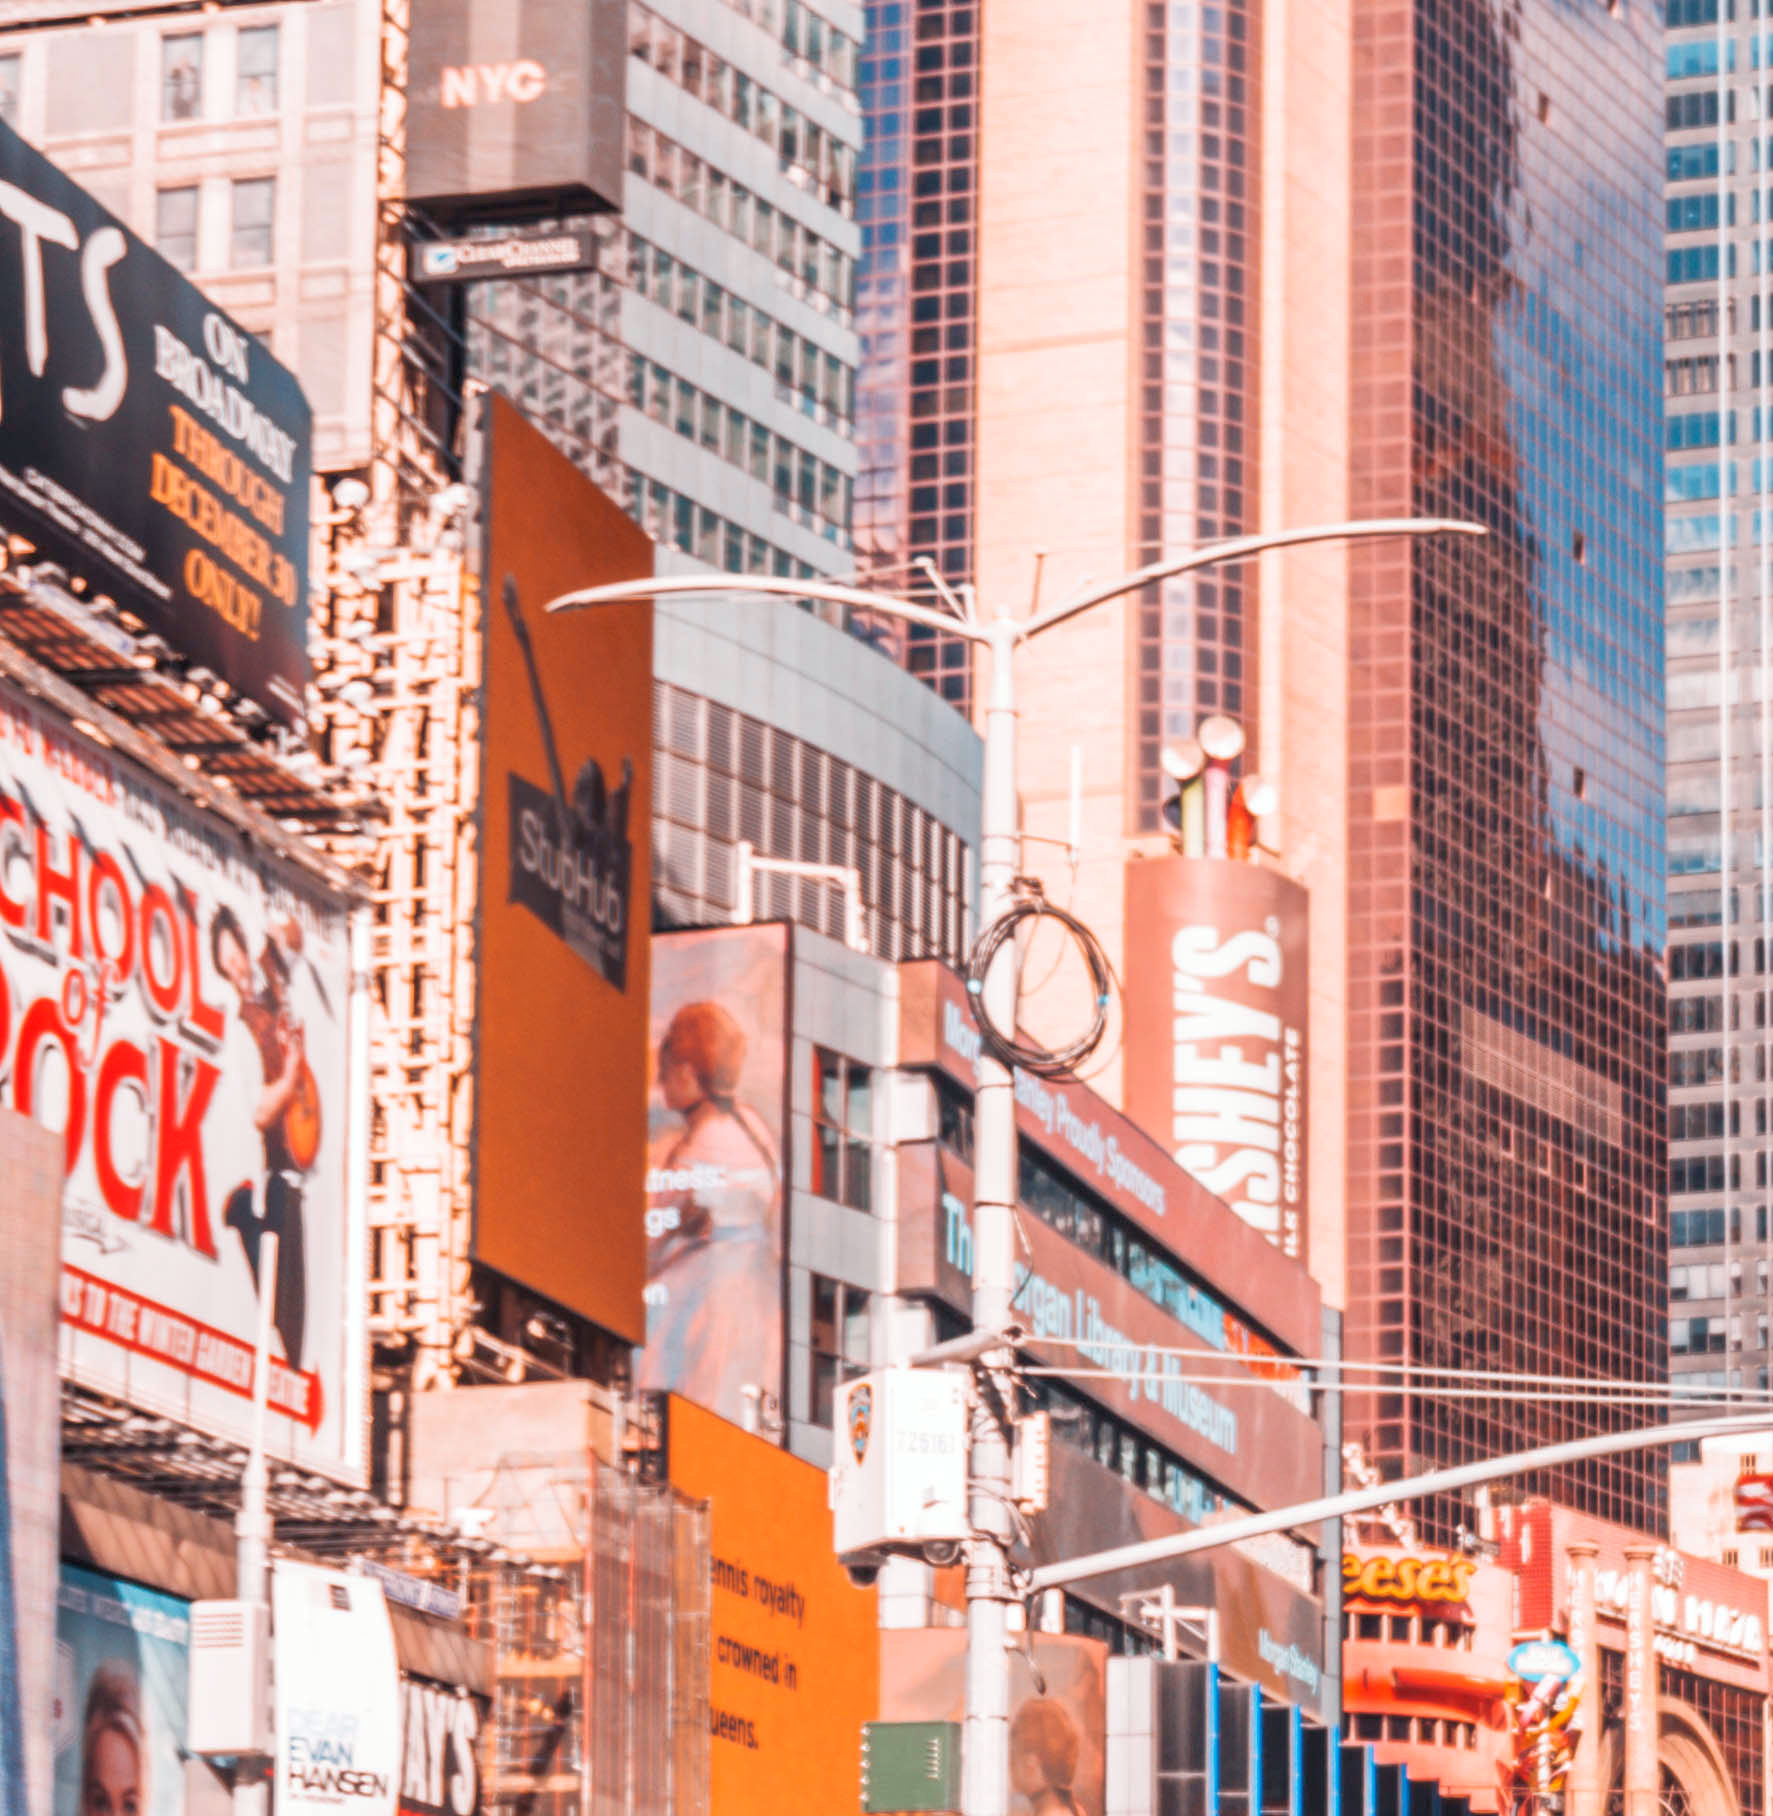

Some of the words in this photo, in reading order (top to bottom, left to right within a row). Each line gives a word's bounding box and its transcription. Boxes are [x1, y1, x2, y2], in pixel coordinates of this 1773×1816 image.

[441, 60, 546, 109] NYC
[154, 323, 298, 484] BROADWAY
[203, 312, 249, 385] ON
[149, 452, 272, 594] DECEMBER
[169, 404, 285, 537] THROUGH
[183, 548, 262, 642] ONLY!
[519, 808, 622, 934] StubHub
[0, 955, 219, 1262] OCK
[1056, 1093, 1107, 1176] Proudly
[1105, 1132, 1166, 1217] Sponsors
[1284, 1026, 1301, 1204] CHOCOLATE
[943, 1193, 973, 1276] Th
[1013, 1261, 1072, 1341] organ
[1076, 1289, 1143, 1402] Library
[1163, 1360, 1238, 1456] Museum
[717, 1635, 779, 1685] crowned
[784, 1652, 798, 1692] in
[753, 1575, 805, 1629] royalty
[289, 1735, 353, 1766] EVAN
[289, 1764, 388, 1798] HANSEN
